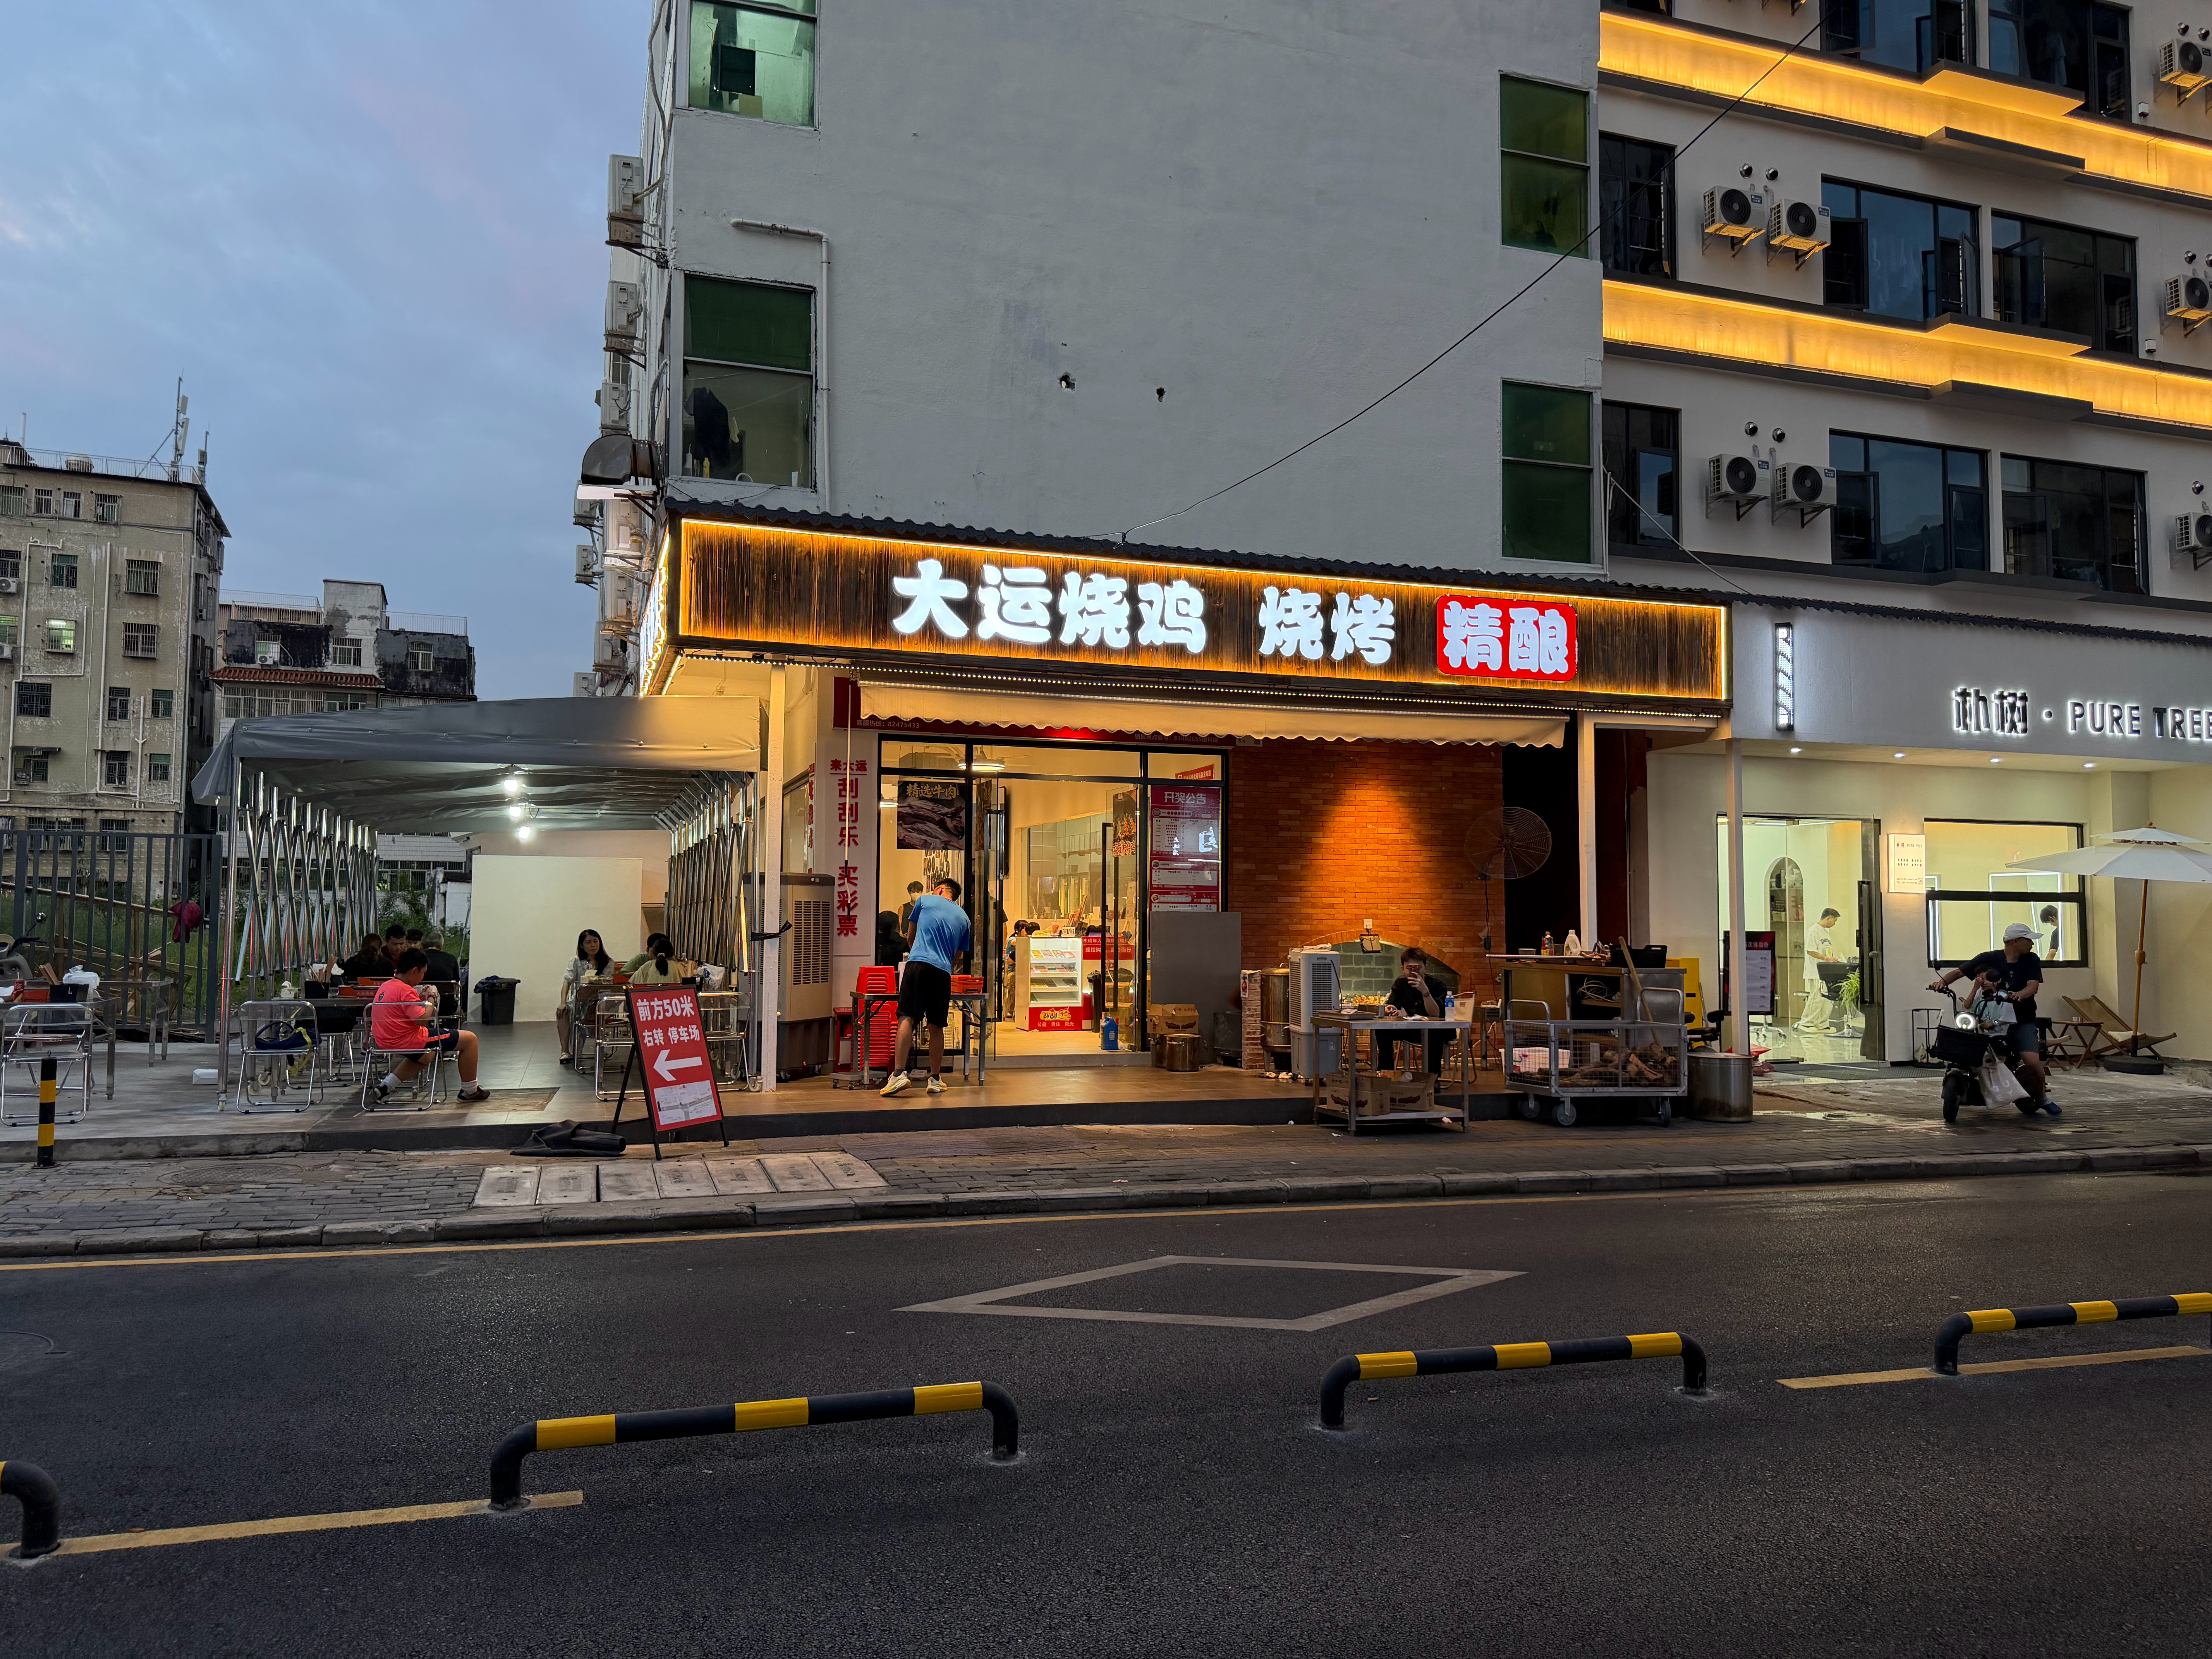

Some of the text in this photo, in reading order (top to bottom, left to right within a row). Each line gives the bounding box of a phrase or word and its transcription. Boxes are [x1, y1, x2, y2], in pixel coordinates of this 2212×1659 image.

[893, 559, 1568, 674] 大运烧鸡 烧烤 精酿
[2069, 701, 2141, 735] PURE
[2152, 707, 2212, 740] TREE
[830, 759, 867, 771] 来大运
[907, 783, 957, 799] 精选牛肉
[1164, 792, 1206, 804] 开奖公告
[836, 778, 859, 936] 刮刮乐 买彩票
[637, 995, 695, 1021] 前方50米
[643, 1025, 700, 1047] 右转 停车场
